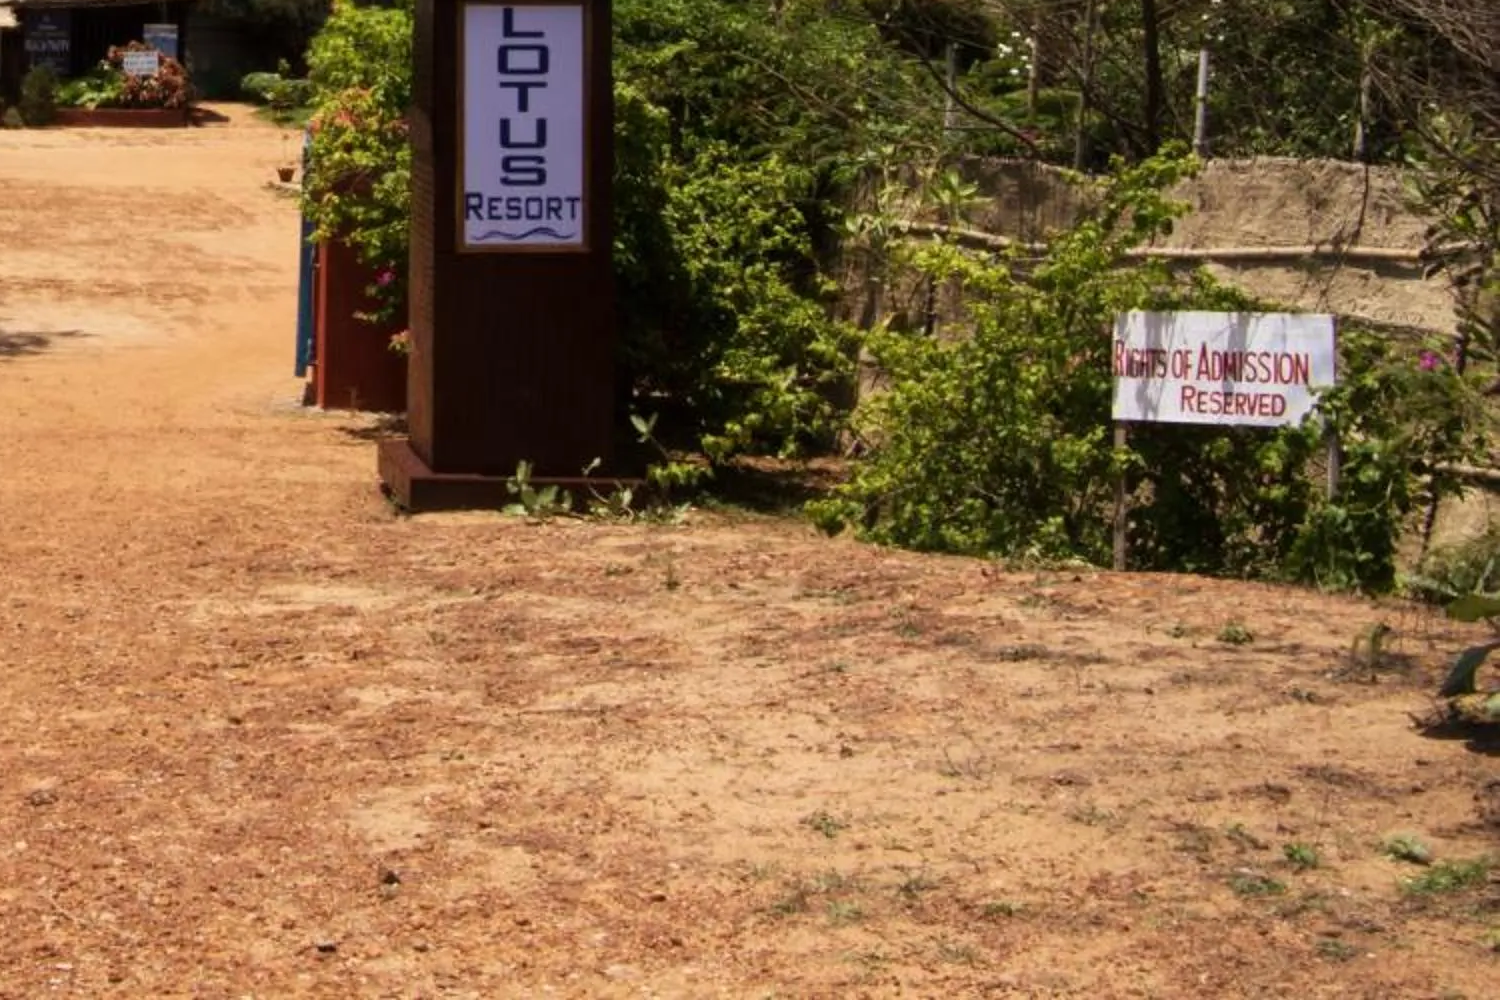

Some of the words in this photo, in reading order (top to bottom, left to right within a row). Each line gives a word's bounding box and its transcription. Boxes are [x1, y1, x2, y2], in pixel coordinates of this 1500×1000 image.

[498, 8, 549, 187] LOTUS
[464, 192, 581, 221] RESORT
[1114, 339, 1167, 379] RIGHTS
[1172, 349, 1192, 381] OF
[1196, 342, 1309, 386] ADMISSION
[1180, 385, 1287, 417] RESERVED
